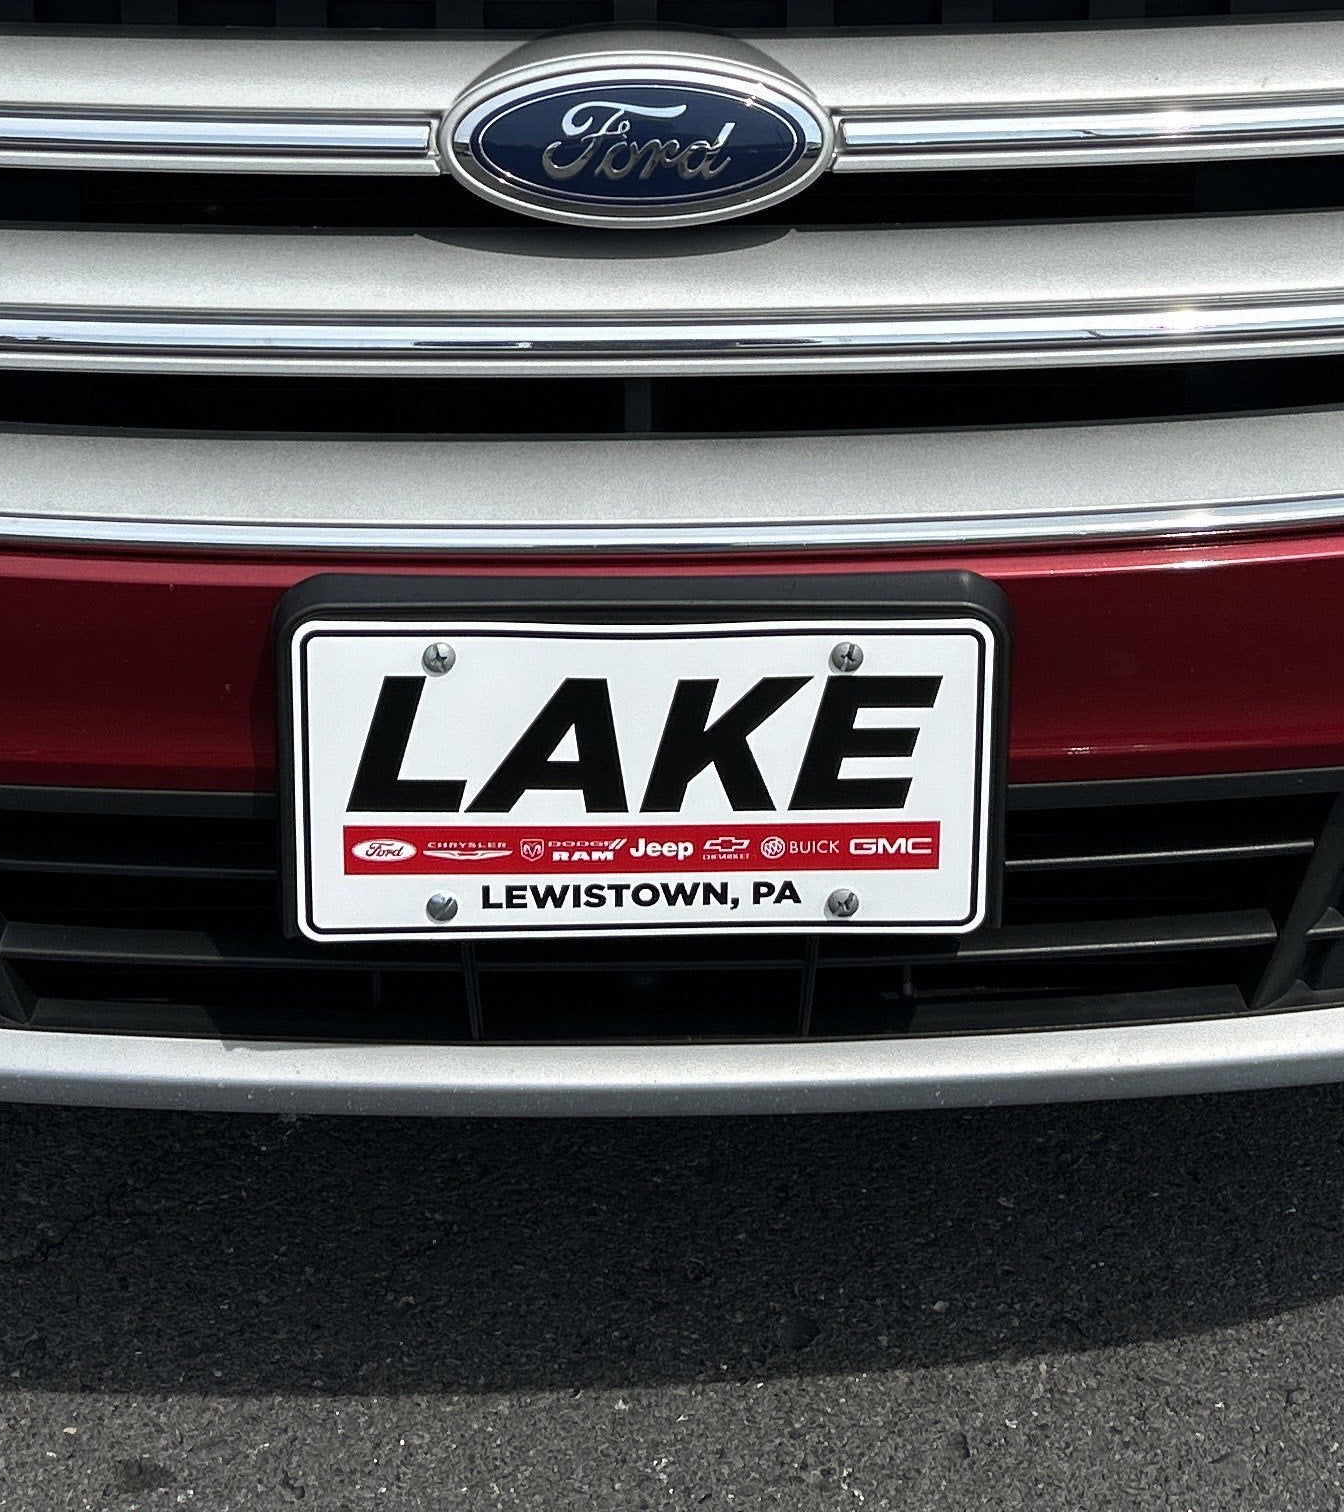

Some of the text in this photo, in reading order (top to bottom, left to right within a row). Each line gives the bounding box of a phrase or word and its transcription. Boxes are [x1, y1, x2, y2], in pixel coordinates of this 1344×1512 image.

[541, 100, 736, 182] Ford
[345, 674, 944, 814] LAKE
[365, 842, 404, 858] Ford
[427, 841, 507, 849] CHRYSLER
[629, 838, 694, 860] Jeep
[789, 839, 840, 854] BUICK
[849, 837, 933, 855] GMC
[552, 851, 615, 862] RAM
[481, 881, 802, 910] LEWISTOWN, PA
